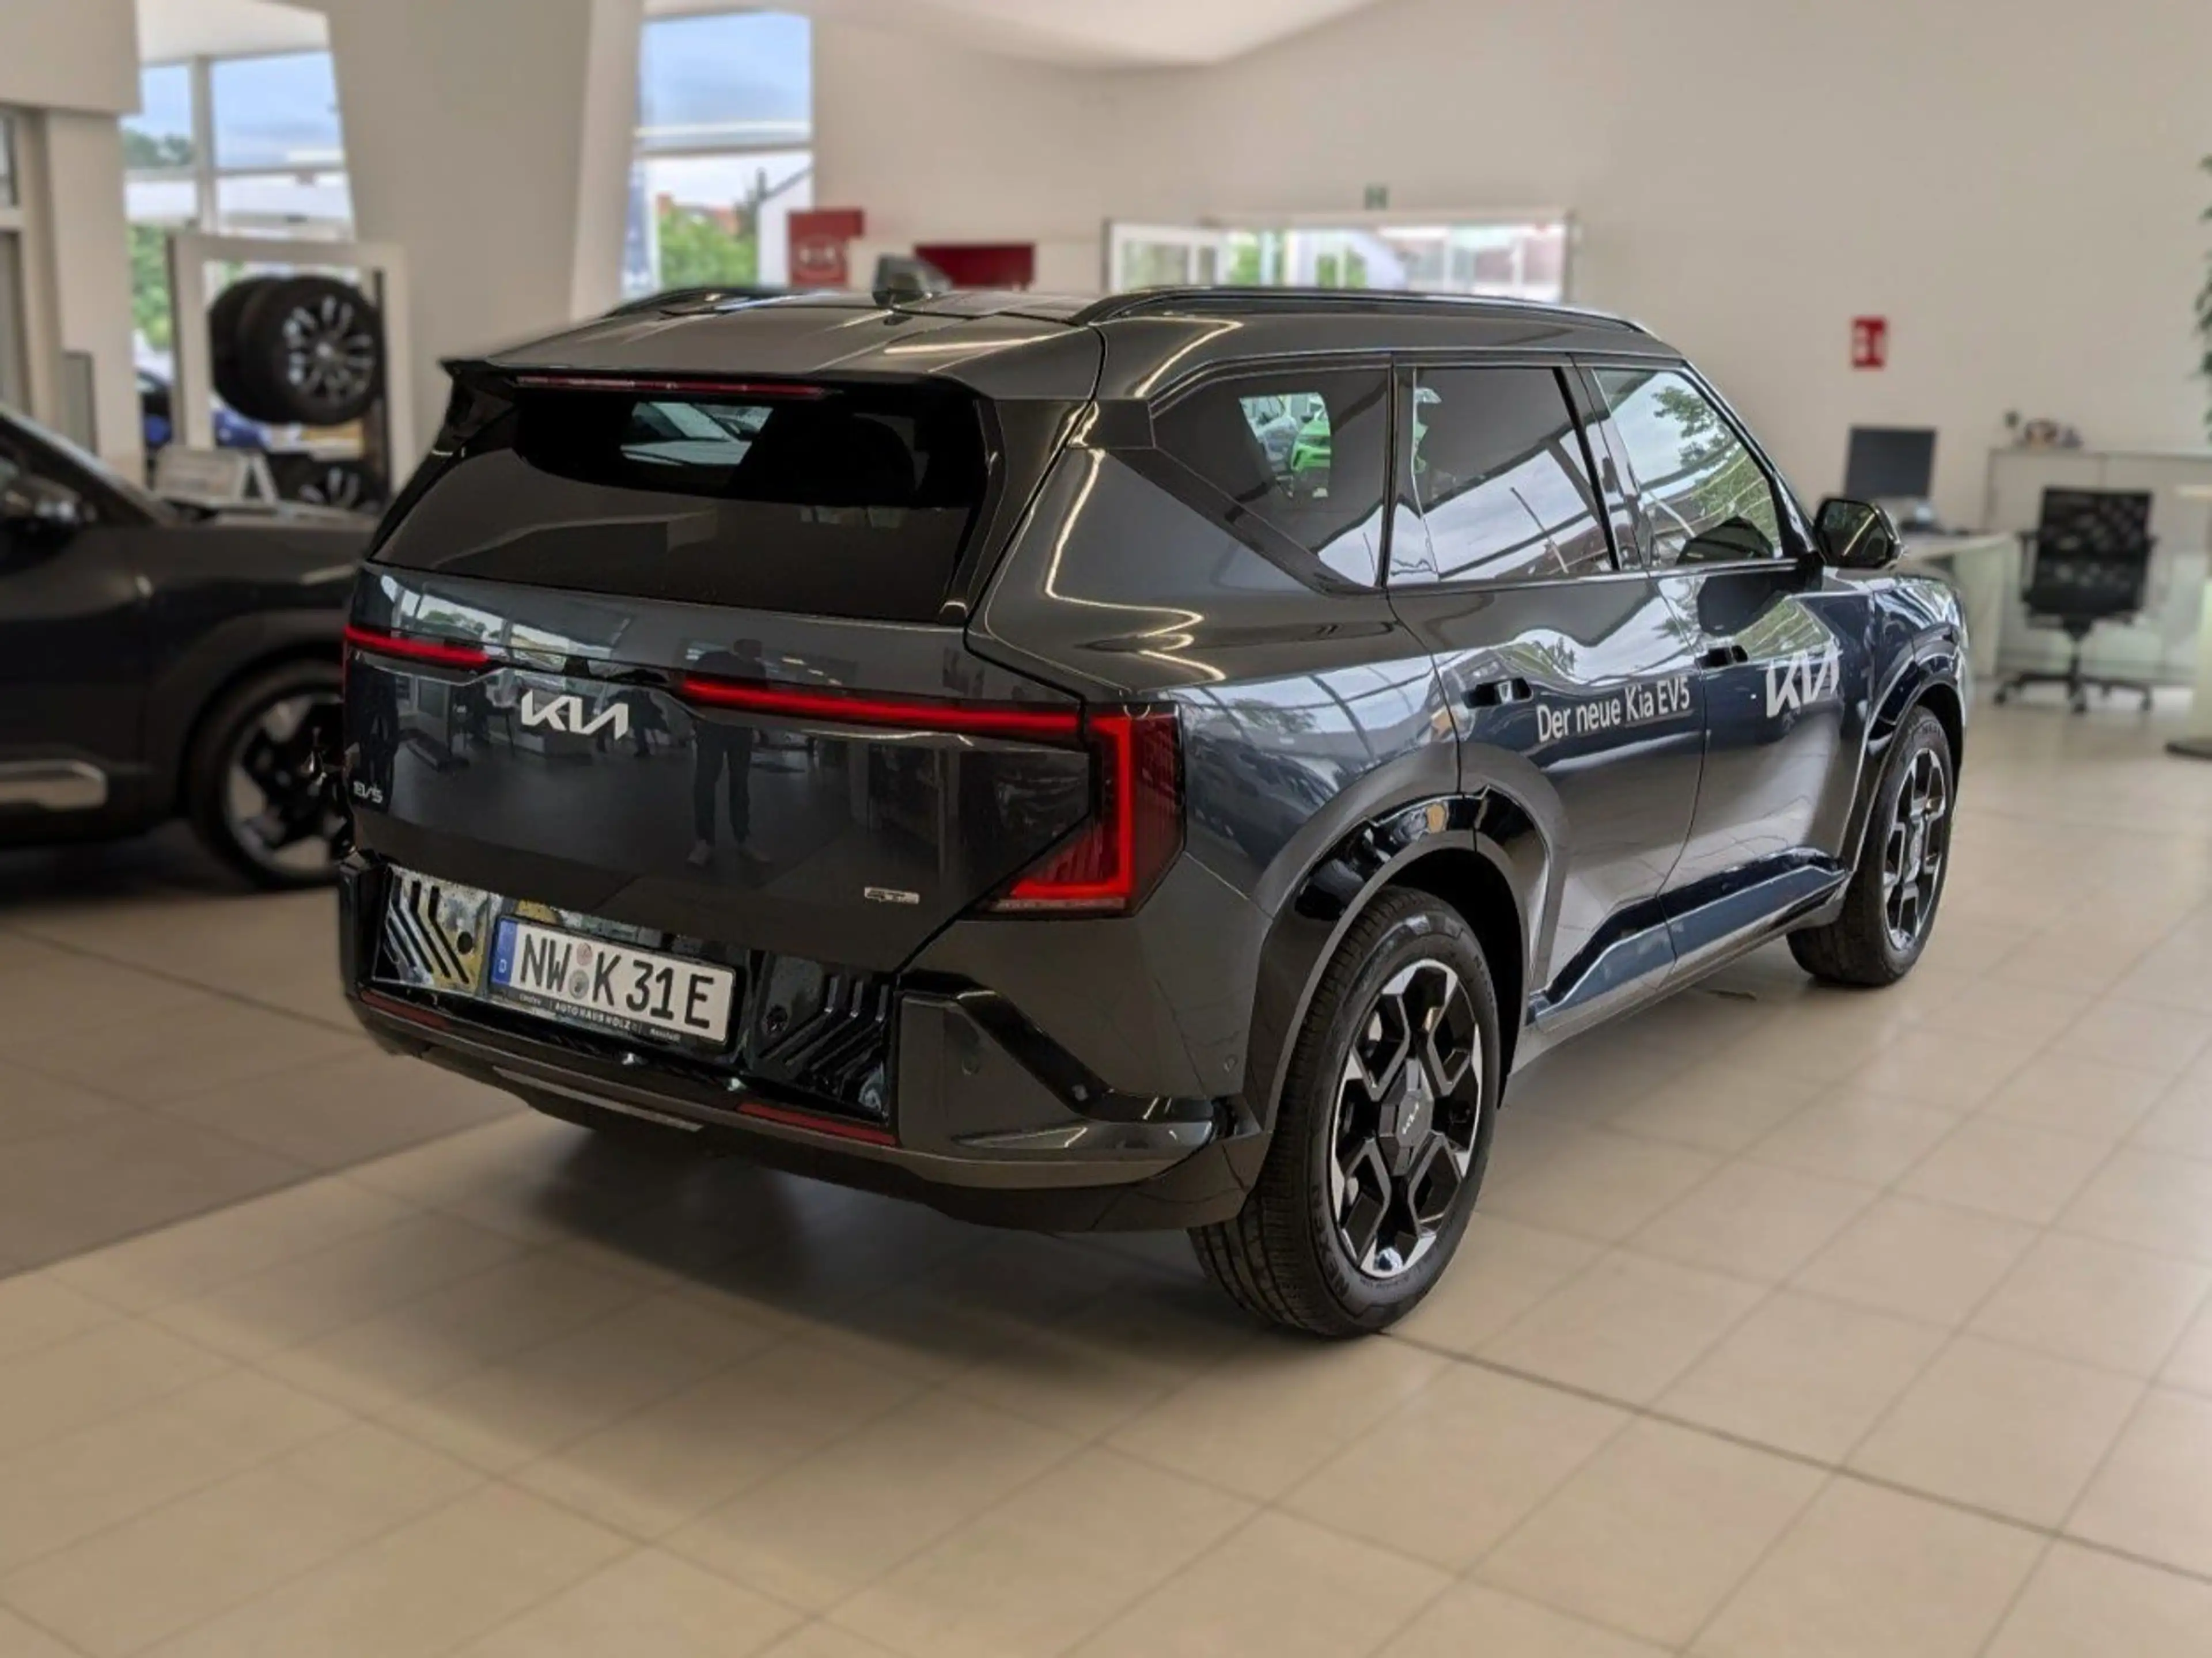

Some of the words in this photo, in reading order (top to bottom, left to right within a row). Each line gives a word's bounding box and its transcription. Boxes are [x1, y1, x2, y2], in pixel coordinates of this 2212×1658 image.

[521, 689, 629, 741] KIA
[1536, 704, 1571, 743] Der
[1575, 697, 1621, 732] neue
[1624, 684, 1654, 721] Kia
[1657, 676, 1690, 715] EV5
[1766, 649, 1840, 718] KIA
[498, 959, 507, 973] D
[520, 934, 571, 993] NW
[592, 951, 622, 1007] K
[626, 959, 675, 1020] 31
[684, 973, 714, 1029] E
